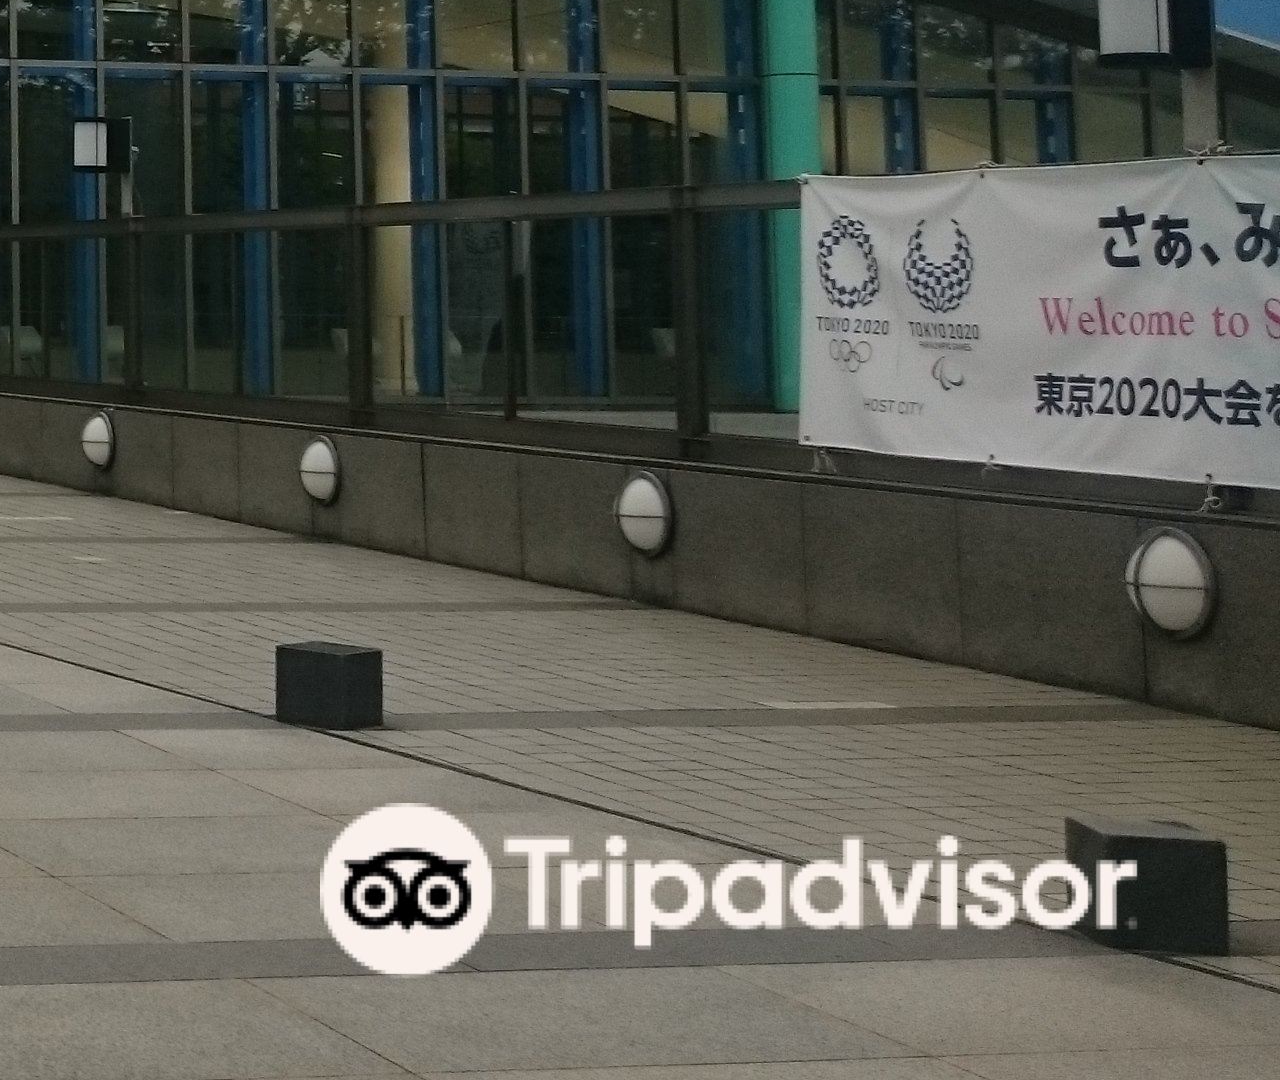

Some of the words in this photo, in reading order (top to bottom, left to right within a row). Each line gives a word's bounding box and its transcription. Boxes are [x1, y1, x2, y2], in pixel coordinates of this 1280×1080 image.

[816, 316, 850, 333] TOKYO
[853, 319, 890, 336] 2020
[1039, 296, 1195, 336] Welcome
[1211, 306, 1250, 338] to
[908, 321, 947, 339] TOKYO
[948, 323, 980, 340] 2020
[863, 397, 895, 413] HOST
[897, 401, 925, 416] CITY
